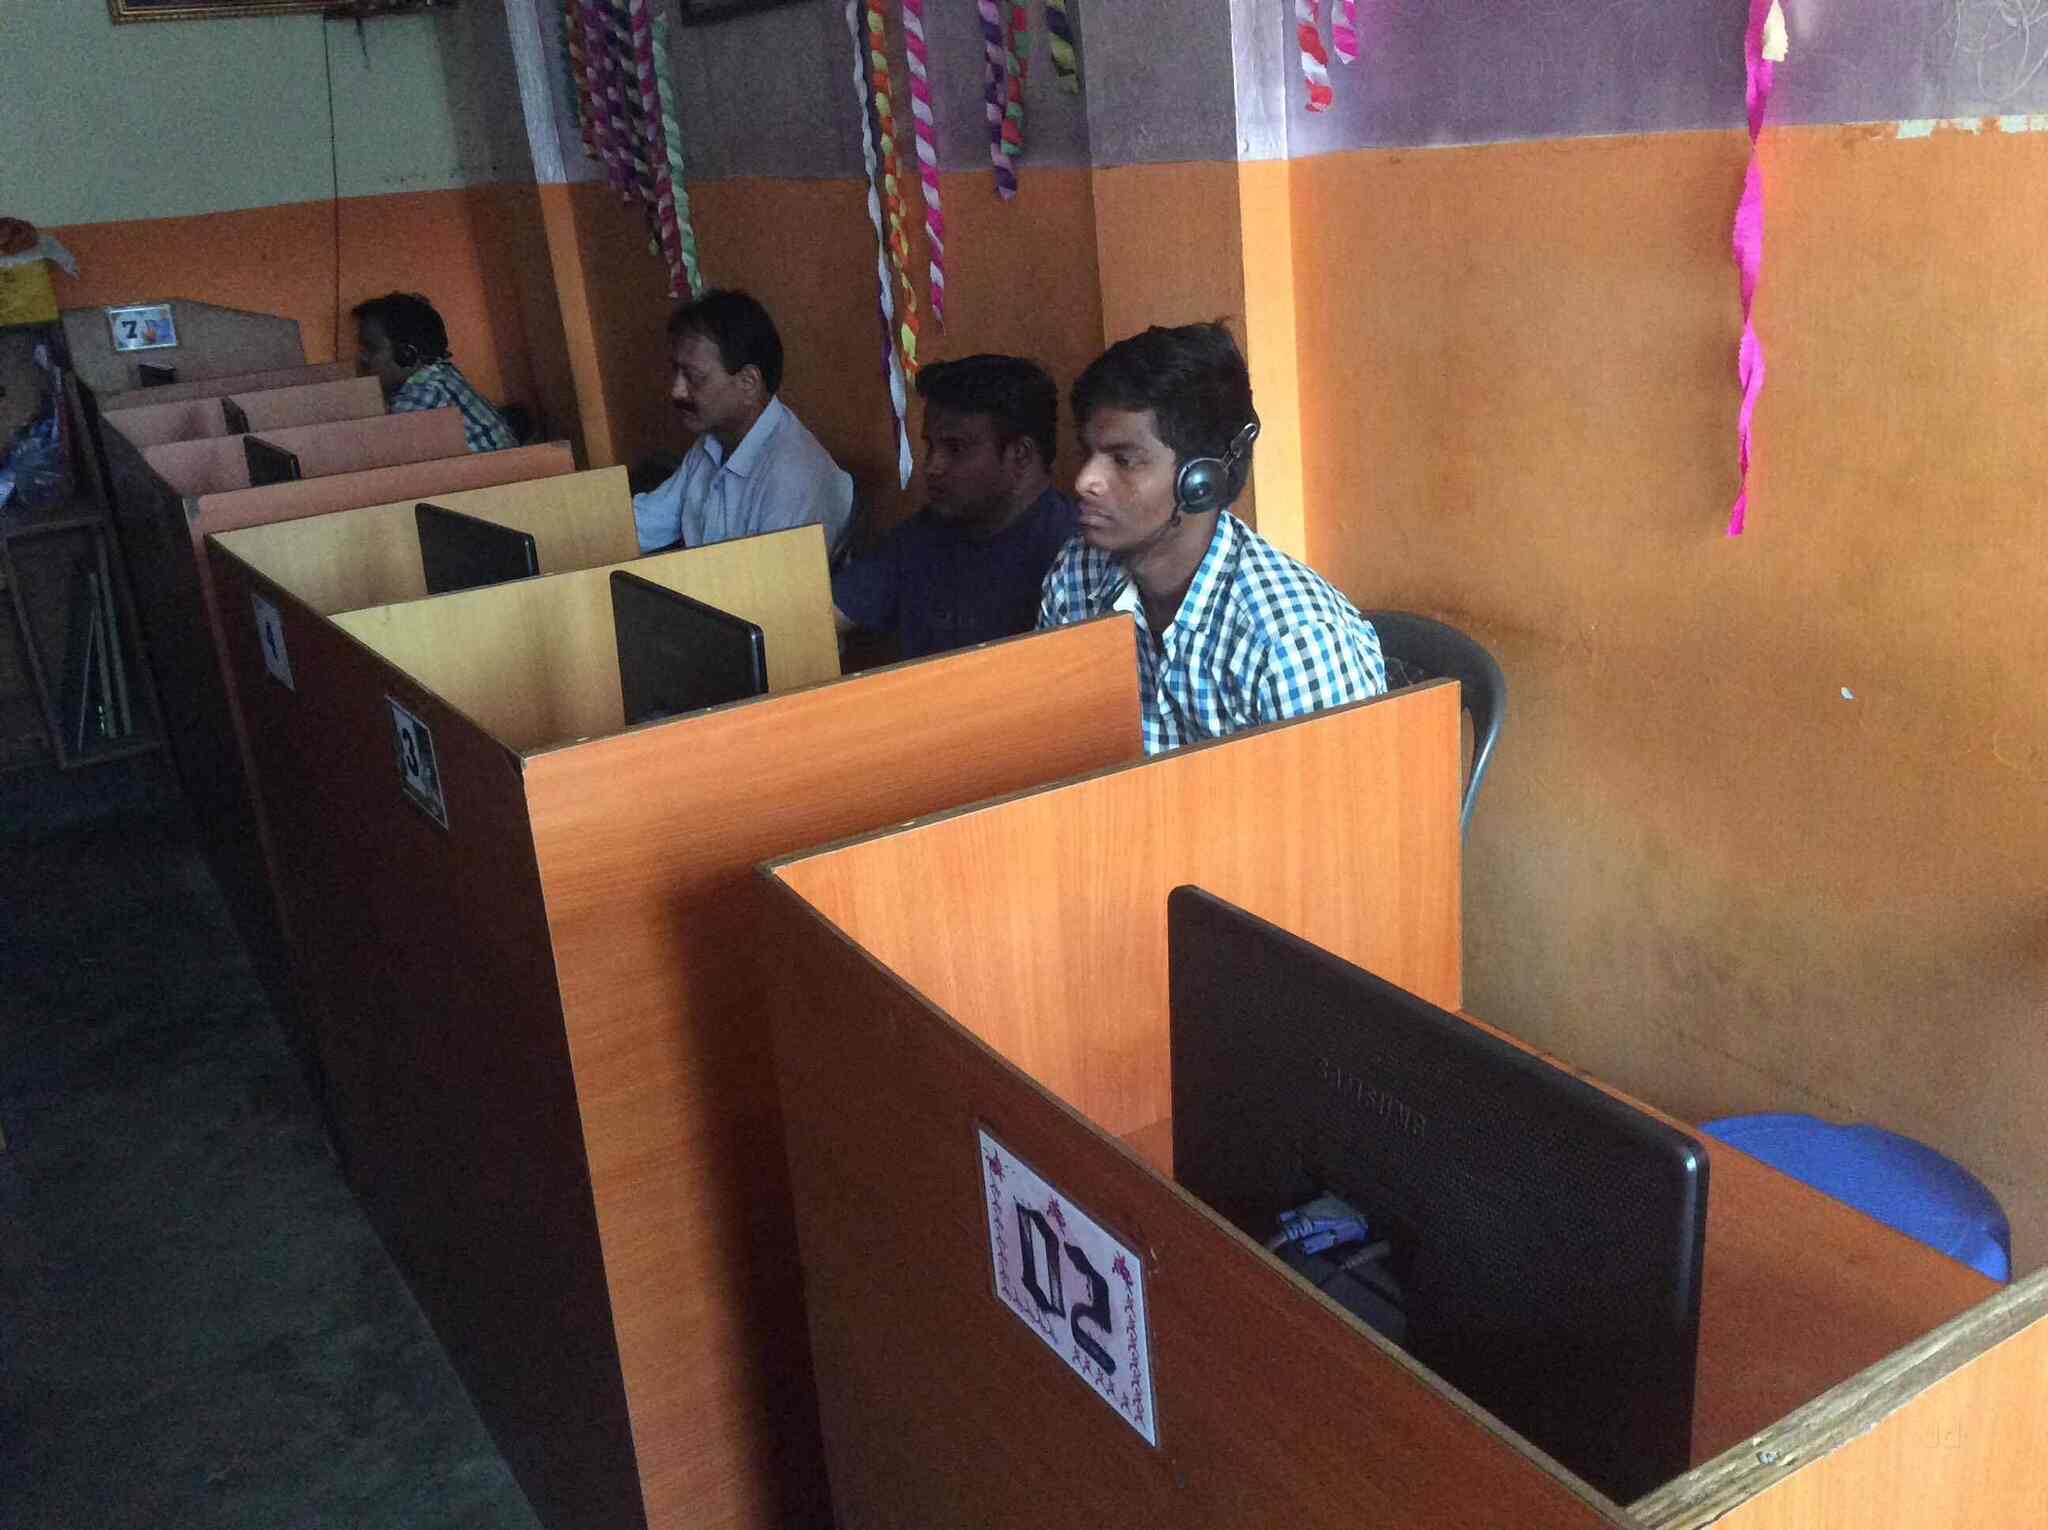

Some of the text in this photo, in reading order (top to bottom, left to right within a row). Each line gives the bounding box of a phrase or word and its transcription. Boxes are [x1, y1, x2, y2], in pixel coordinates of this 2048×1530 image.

[121, 320, 138, 339] 7
[402, 727, 420, 777] 3
[1015, 1201, 1117, 1377] 02
